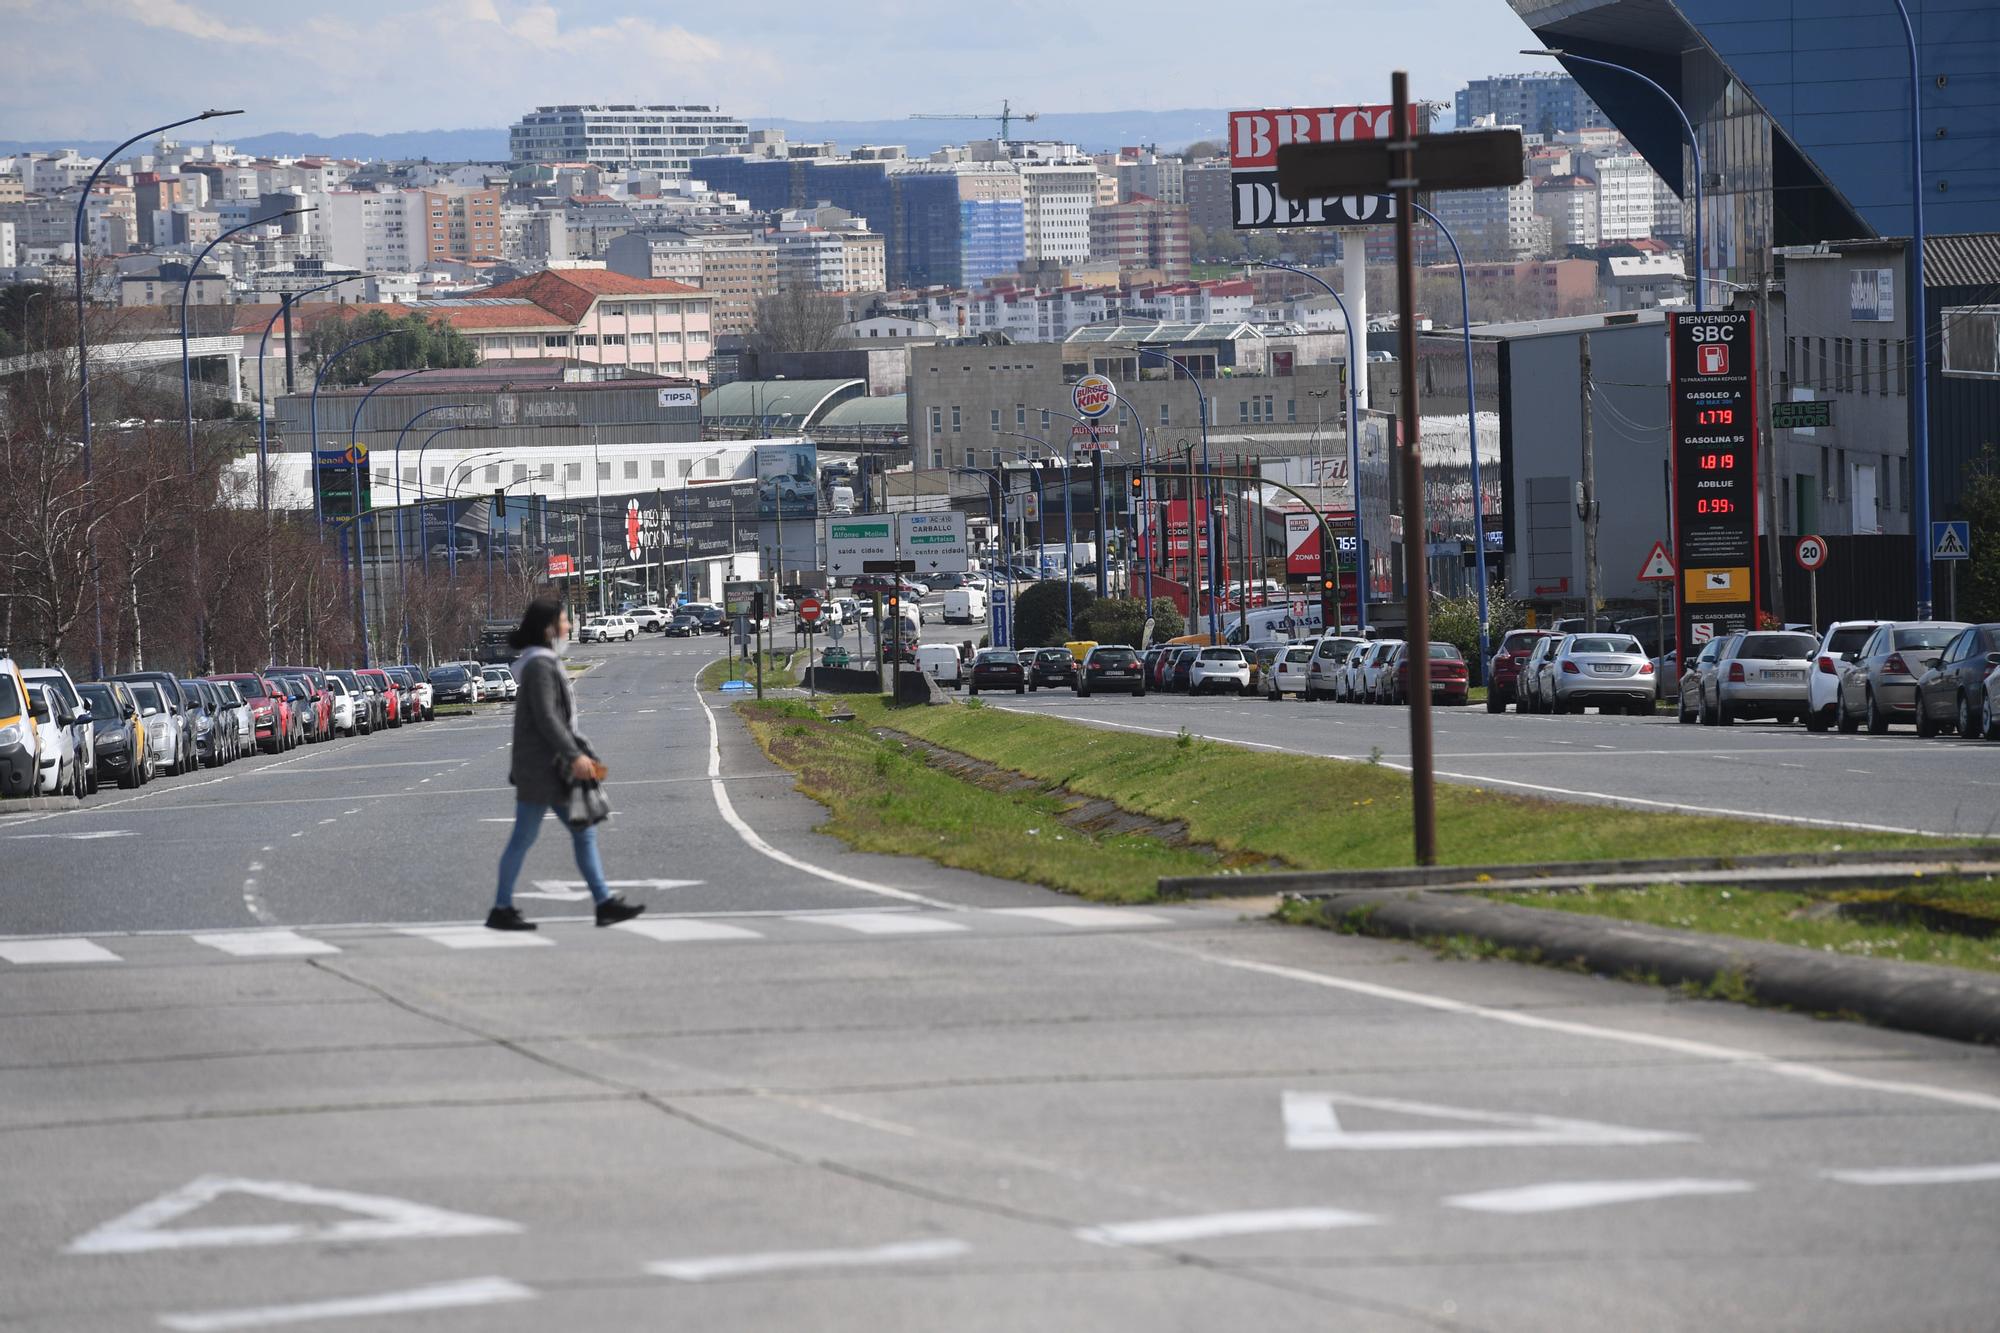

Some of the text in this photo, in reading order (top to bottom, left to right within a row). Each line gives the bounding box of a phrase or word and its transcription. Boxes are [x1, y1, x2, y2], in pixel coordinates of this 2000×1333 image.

[1679, 314, 1746, 324] BIENVENIDO A
[1691, 325, 1734, 342] SBC
[1077, 384, 1108, 398] BURGER
[663, 393, 692, 401] TIPSA
[1077, 391, 1109, 408] KING
[1700, 410, 1733, 424] 1.779
[1685, 436, 1731, 444] GASOLINA
[915, 547, 965, 555] centro cidade
[1802, 547, 1818, 558] 20
